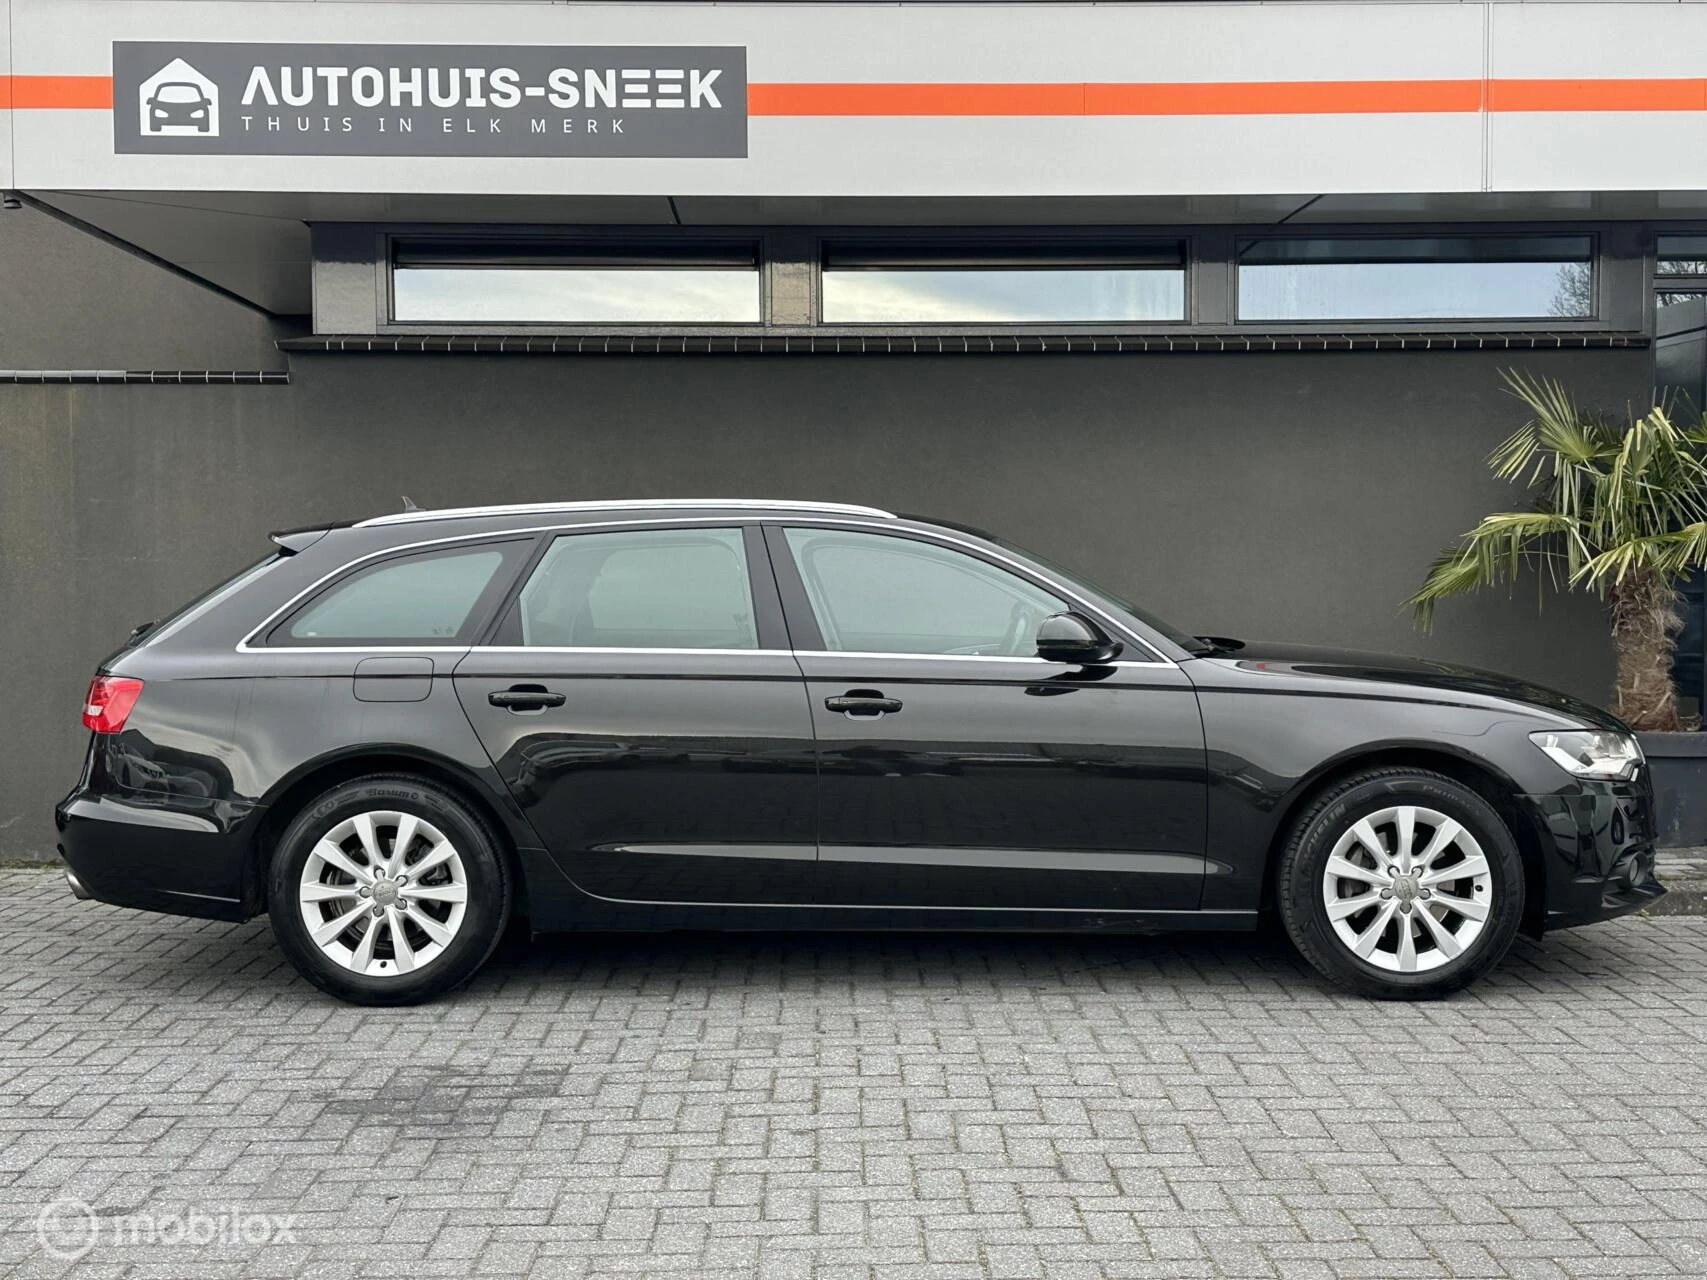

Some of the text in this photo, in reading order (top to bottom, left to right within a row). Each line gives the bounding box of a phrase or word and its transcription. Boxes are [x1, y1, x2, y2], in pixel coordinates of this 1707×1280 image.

[240, 65, 723, 109] AUTOHUIS-SNEEK
[240, 115, 625, 134] THUIS IN ELK MERK
